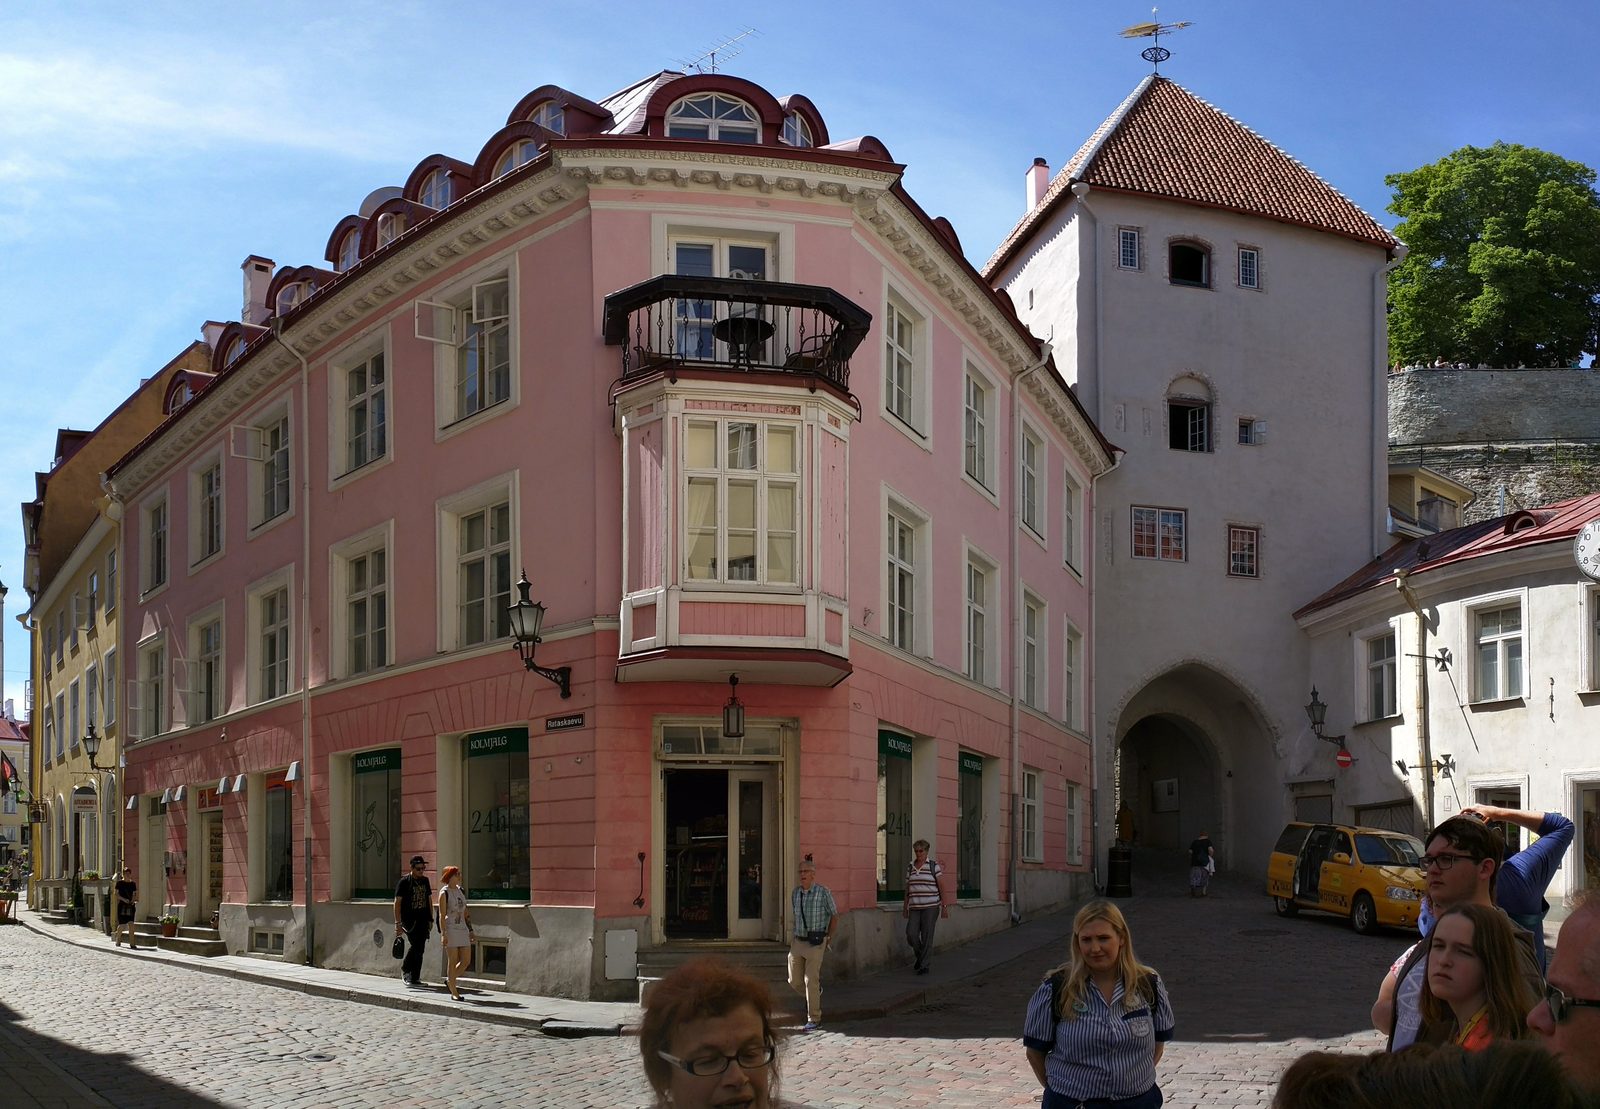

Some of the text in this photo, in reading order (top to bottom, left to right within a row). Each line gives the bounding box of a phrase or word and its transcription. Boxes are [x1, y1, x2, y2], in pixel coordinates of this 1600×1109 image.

[1583, 533, 1592, 541] 10
[1579, 545, 1586, 553] 9
[1582, 556, 1589, 565] 8
[1592, 564, 1599, 573] 7
[471, 808, 507, 834] 24h
